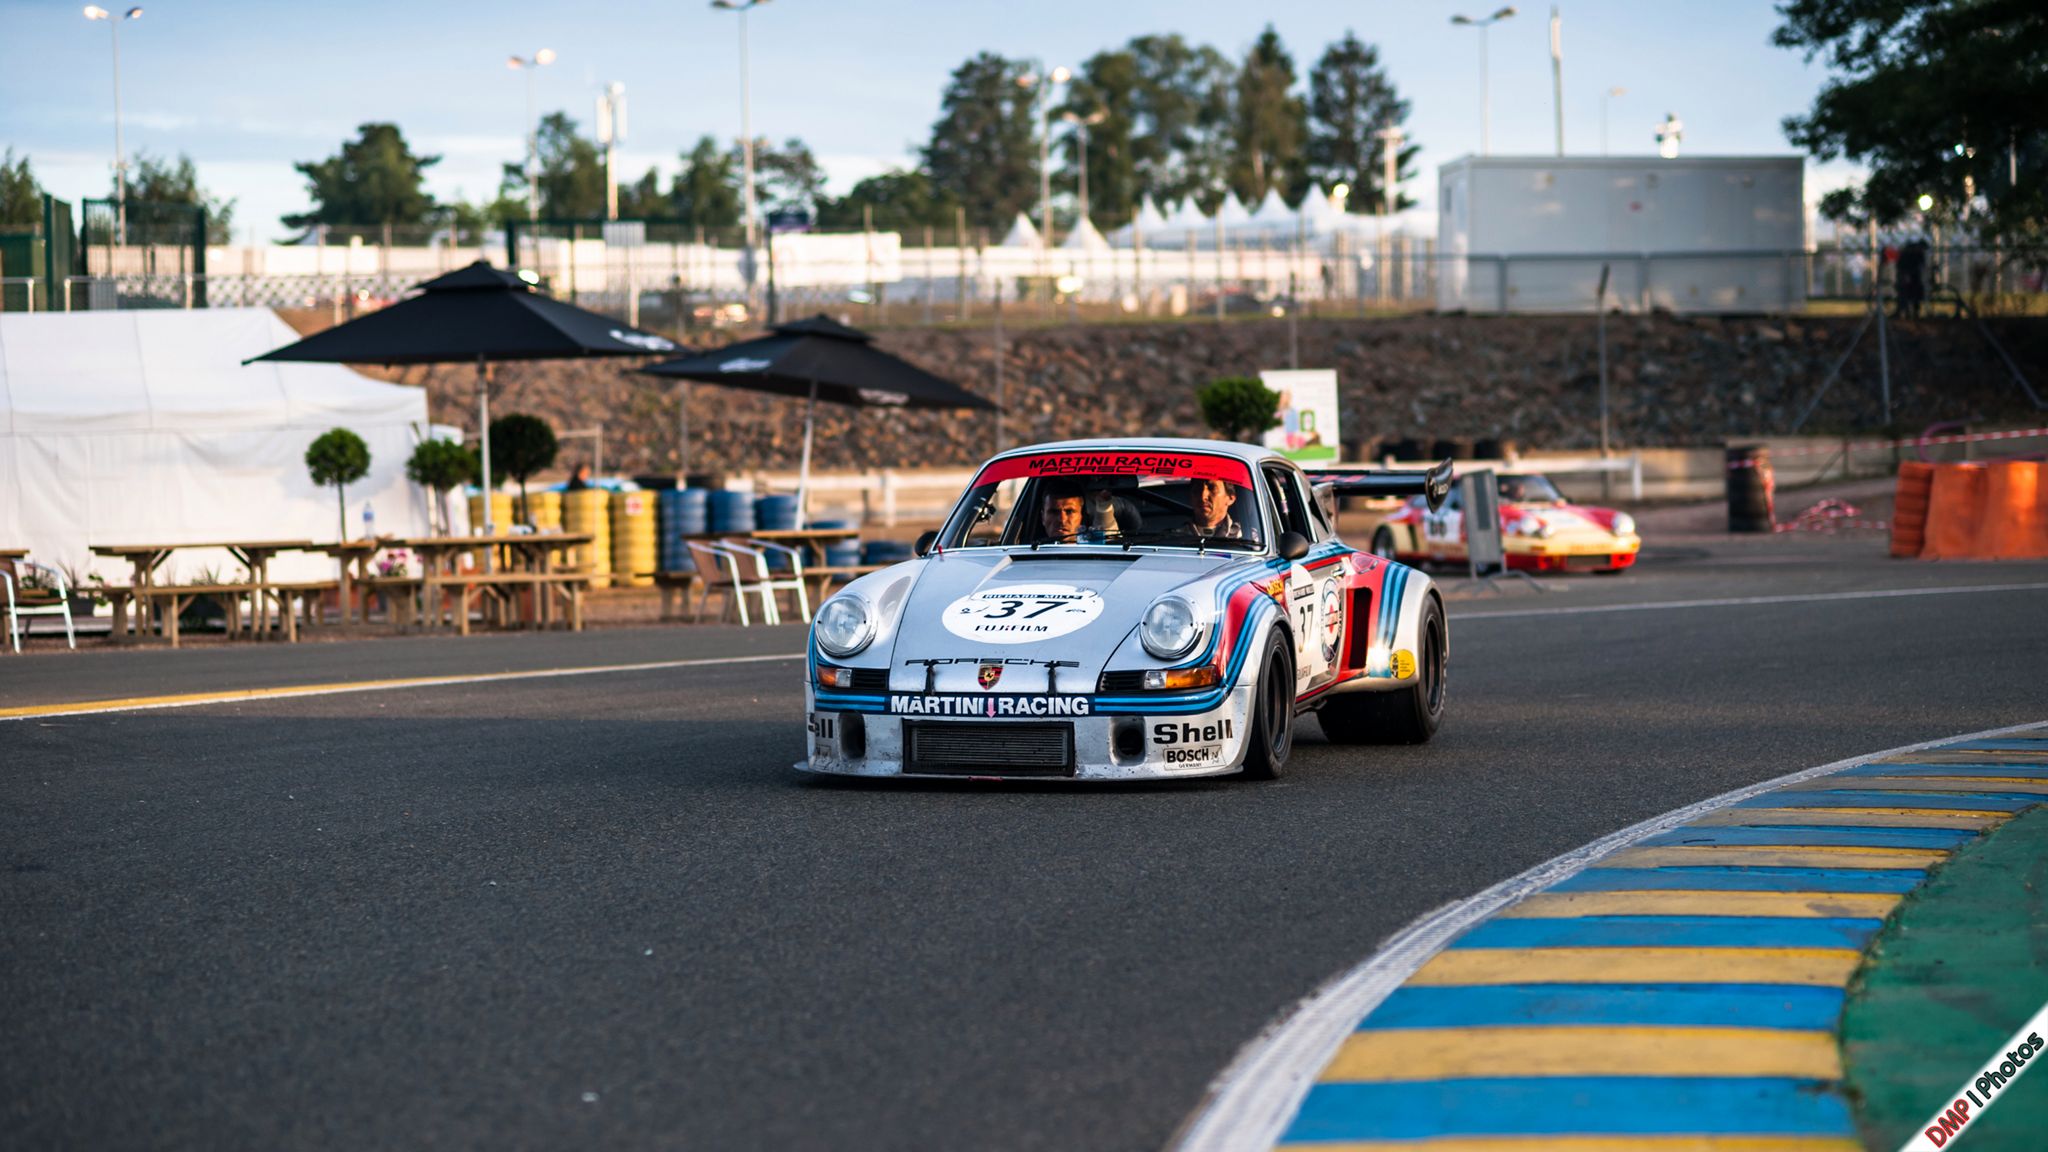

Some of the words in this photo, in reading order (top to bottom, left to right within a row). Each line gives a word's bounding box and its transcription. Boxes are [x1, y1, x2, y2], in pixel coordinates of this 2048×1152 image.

[1029, 456, 1110, 469] MARTINI
[1114, 456, 1193, 469] RACING
[1039, 465, 1175, 475] PORSCHE
[984, 600, 1069, 619] 37
[1299, 603, 1314, 653] 37
[905, 658, 1080, 668] PORSCHE
[891, 695, 984, 714] MARTINI
[998, 697, 1090, 715] RACING
[1153, 719, 1233, 744] Shell
[1166, 748, 1209, 763] BOSCH
